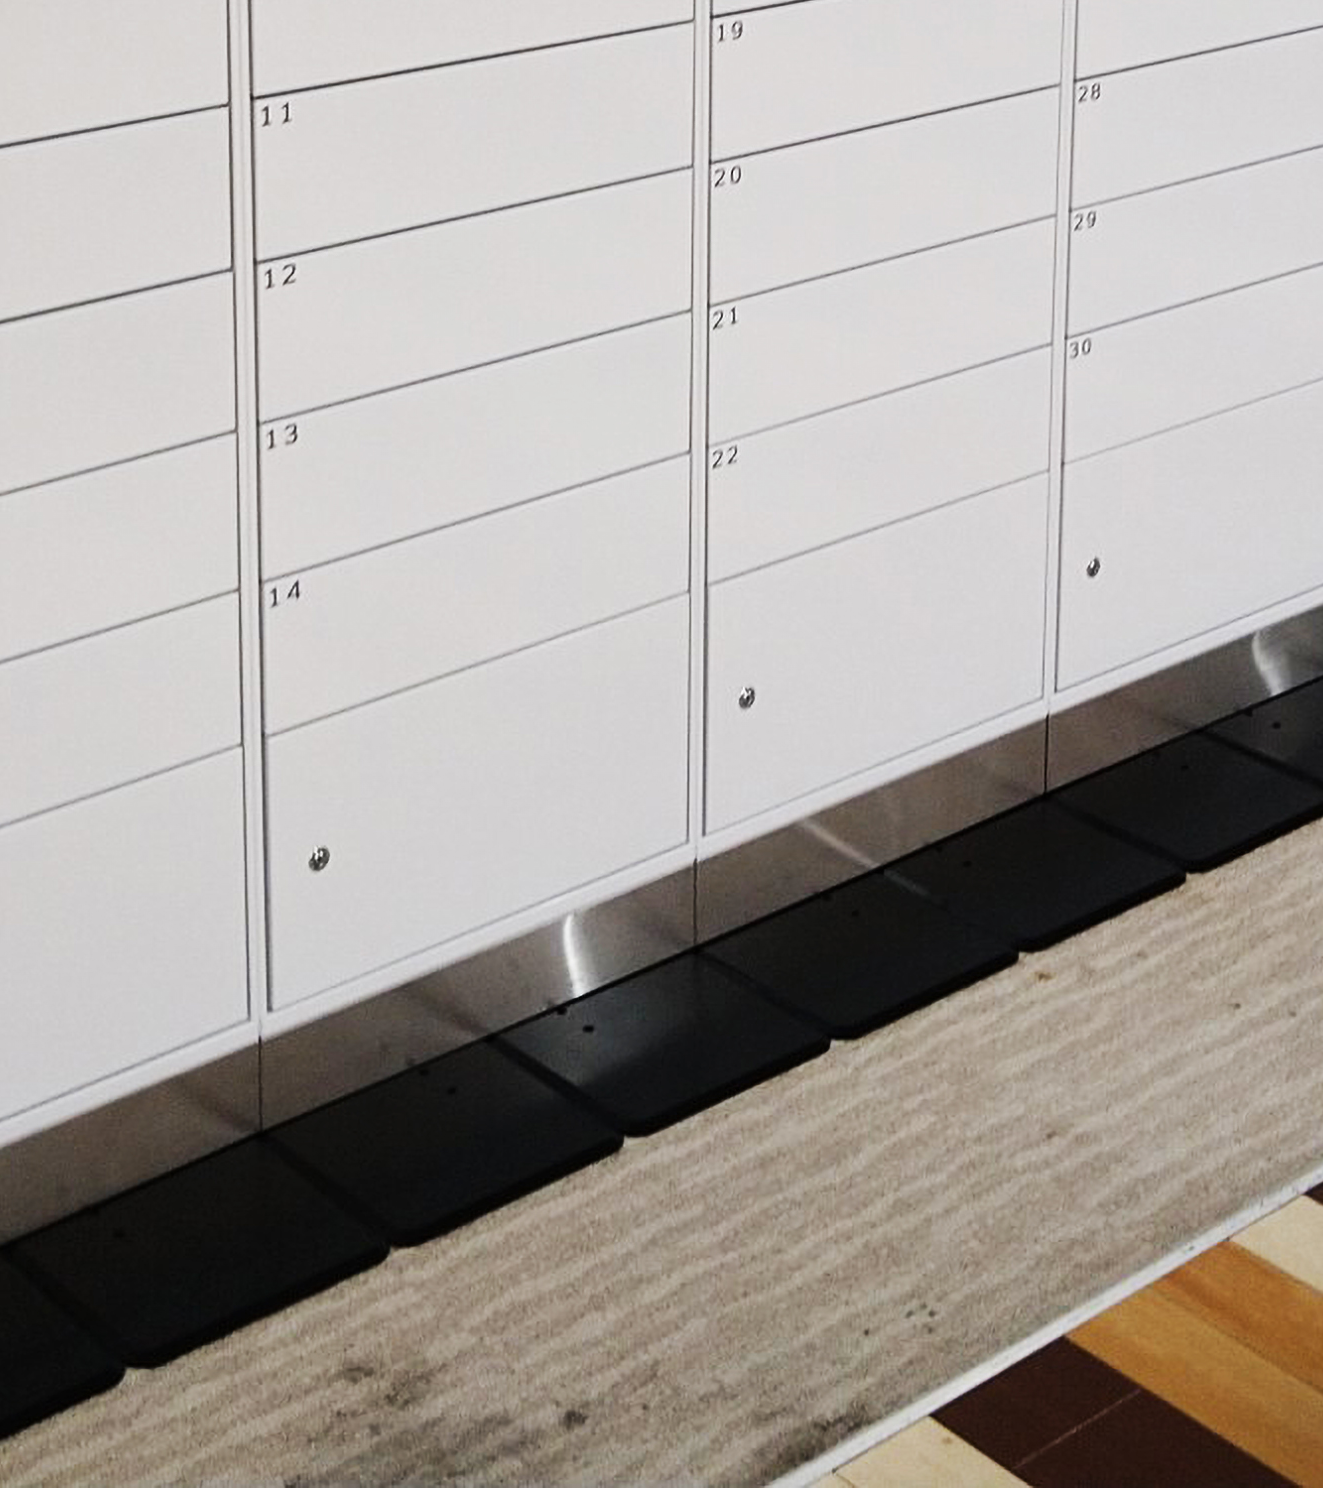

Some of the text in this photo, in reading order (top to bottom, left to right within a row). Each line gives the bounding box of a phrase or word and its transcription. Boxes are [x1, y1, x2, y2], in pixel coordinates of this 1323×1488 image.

[719, 21, 743, 42] 19
[1079, 82, 1100, 101] 28
[262, 103, 292, 126] 11
[714, 166, 741, 188] 20
[1074, 211, 1096, 230] 29
[265, 264, 297, 289] 12
[713, 307, 737, 330] 21
[1070, 339, 1091, 358] 30
[267, 424, 298, 449] 13
[713, 446, 738, 469] 22
[270, 580, 300, 607] 14
